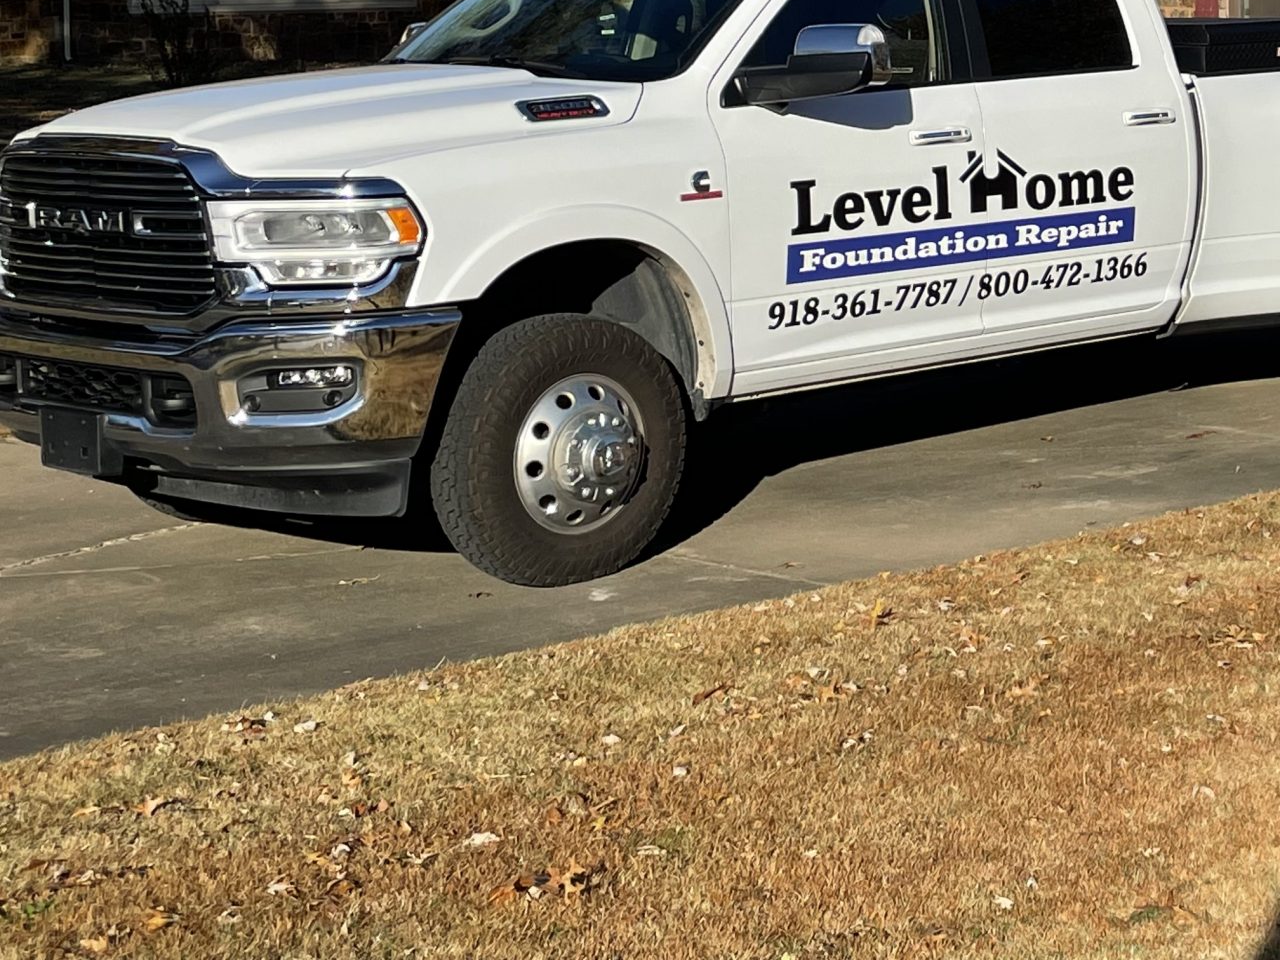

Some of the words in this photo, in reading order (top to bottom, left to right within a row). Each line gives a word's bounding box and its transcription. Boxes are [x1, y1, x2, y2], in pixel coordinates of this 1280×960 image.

[38, 206, 124, 232] RAM
[790, 166, 951, 235] Level
[960, 148, 1134, 214] Home
[798, 232, 1009, 274] Foundation
[1015, 215, 1124, 249] Repair
[768, 278, 957, 330] 918-361-7787
[977, 252, 1148, 300] 800-472-1366
